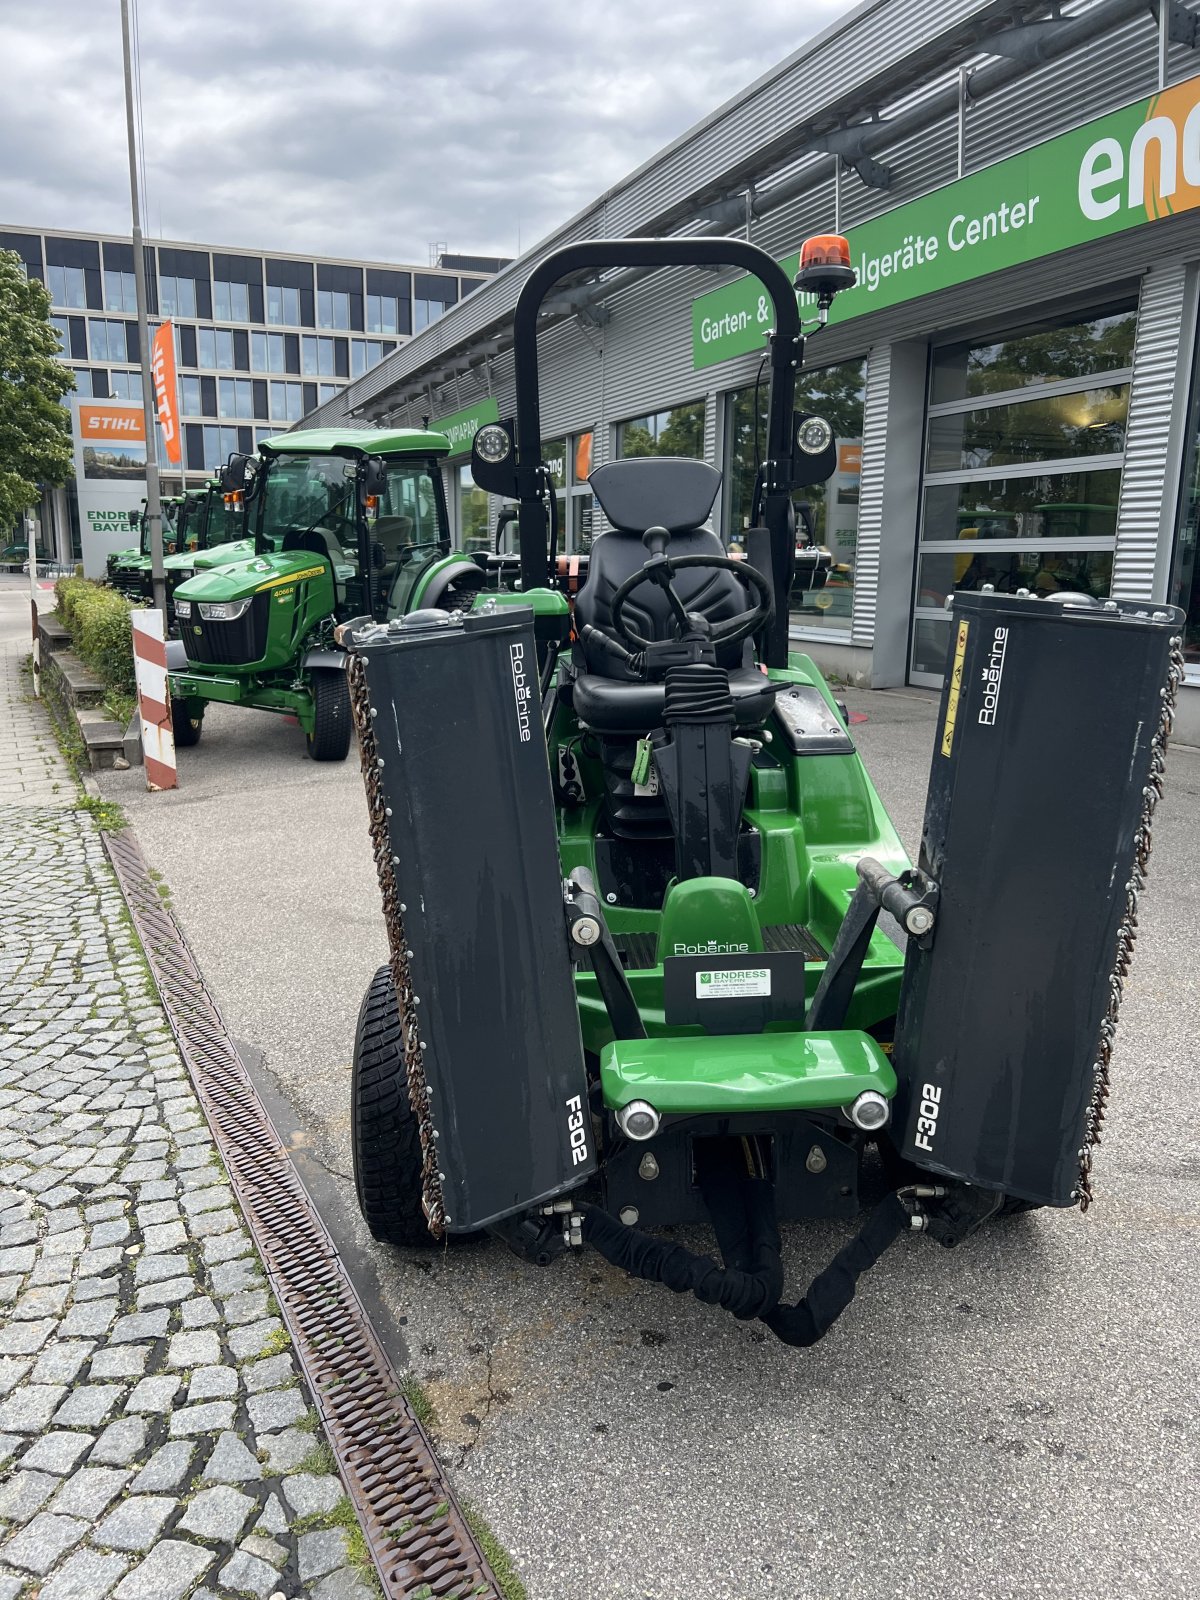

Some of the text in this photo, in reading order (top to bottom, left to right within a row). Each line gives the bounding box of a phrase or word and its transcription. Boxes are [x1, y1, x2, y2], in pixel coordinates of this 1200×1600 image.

[700, 311, 752, 344] Garten-
[756, 295, 769, 323] &
[947, 195, 1040, 251] Center
[88, 416, 140, 431] STIHL
[93, 523, 139, 532] BAYER
[510, 643, 531, 742] Roberine
[978, 627, 1007, 725] Roberine
[674, 941, 749, 955] Roberine
[714, 970, 767, 979] ENDRESS
[565, 1094, 588, 1166] F302
[914, 1083, 942, 1152] F302
